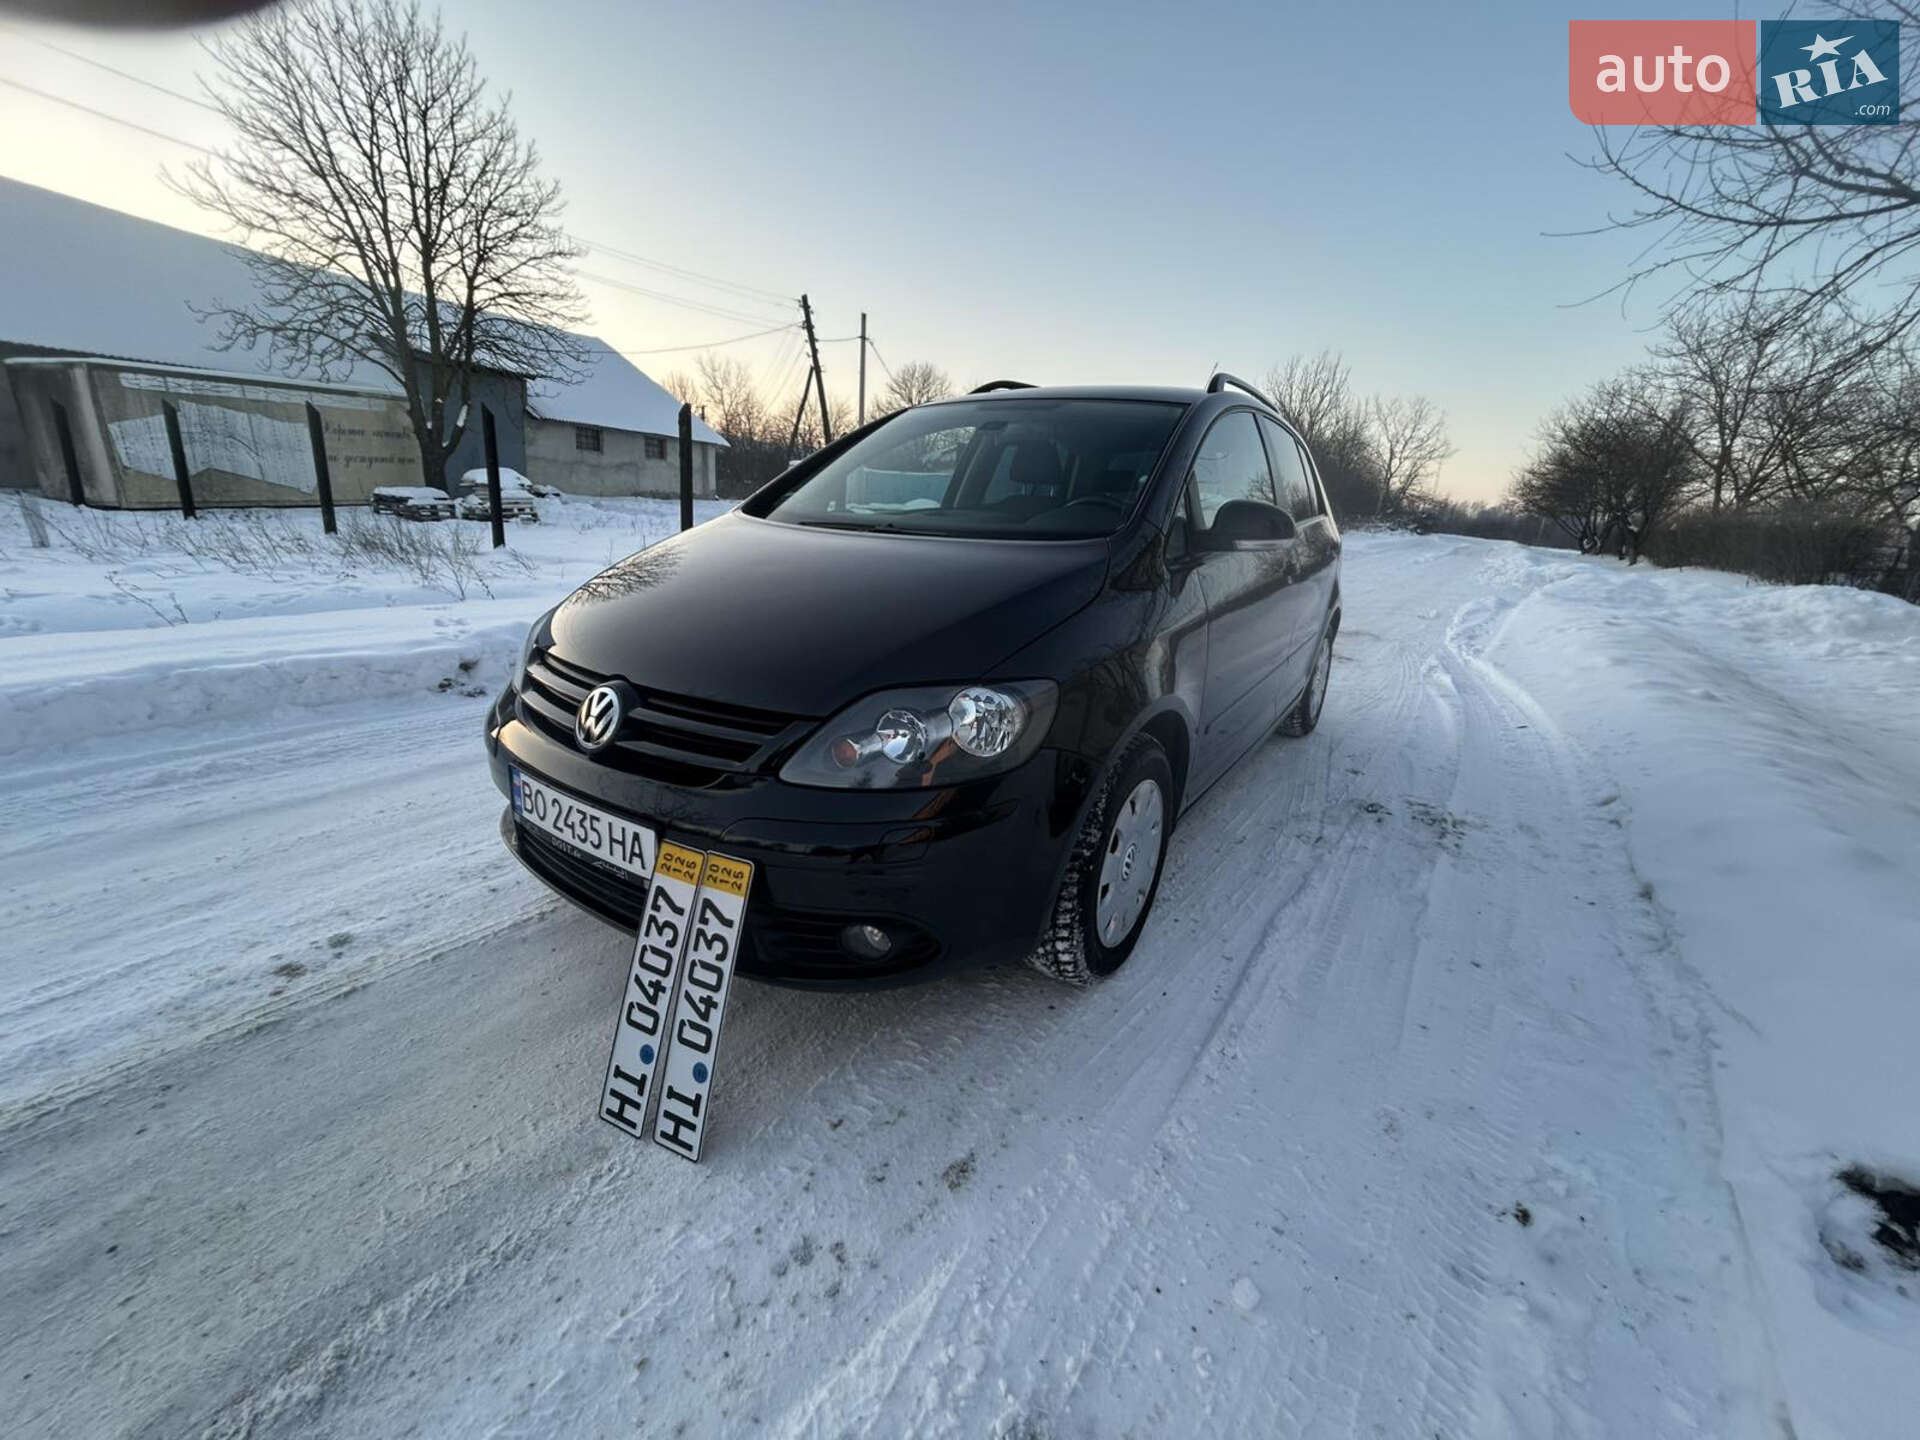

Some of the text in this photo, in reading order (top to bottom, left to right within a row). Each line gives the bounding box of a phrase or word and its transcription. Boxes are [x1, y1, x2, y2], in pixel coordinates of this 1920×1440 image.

[521, 779, 547, 822] BO
[551, 797, 603, 850] 2435
[608, 821, 647, 871] HA
[660, 852, 674, 873] 20
[672, 856, 686, 874] 12
[706, 863, 720, 884] 20
[719, 866, 733, 885] 12
[605, 885, 685, 1130] HI 04037
[659, 897, 735, 1152] HI 04037
